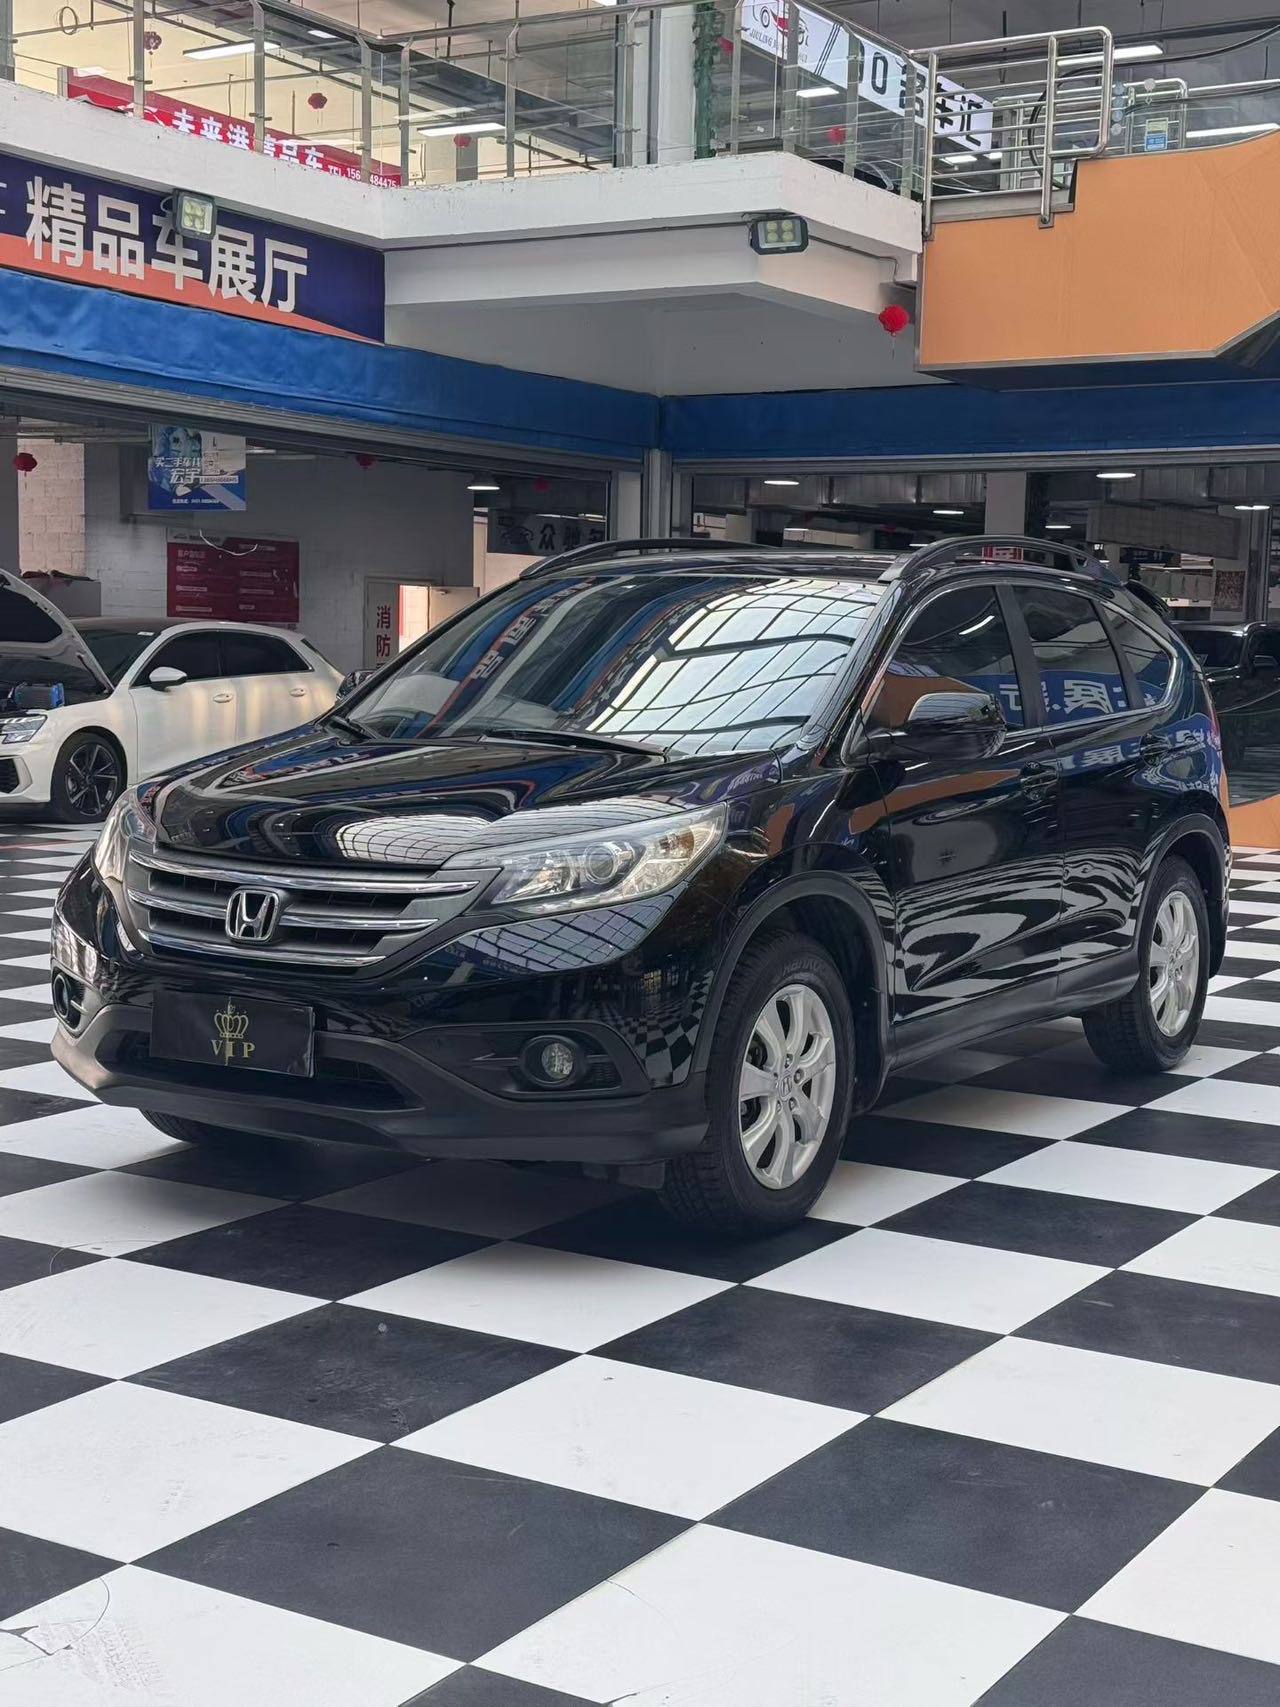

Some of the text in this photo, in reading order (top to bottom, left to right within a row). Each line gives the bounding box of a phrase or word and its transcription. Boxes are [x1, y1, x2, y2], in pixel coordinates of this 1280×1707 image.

[0, 176, 308, 313] 精品车展厅
[376, 605, 391, 668] 消防
[211, 1039, 256, 1058] VIP
